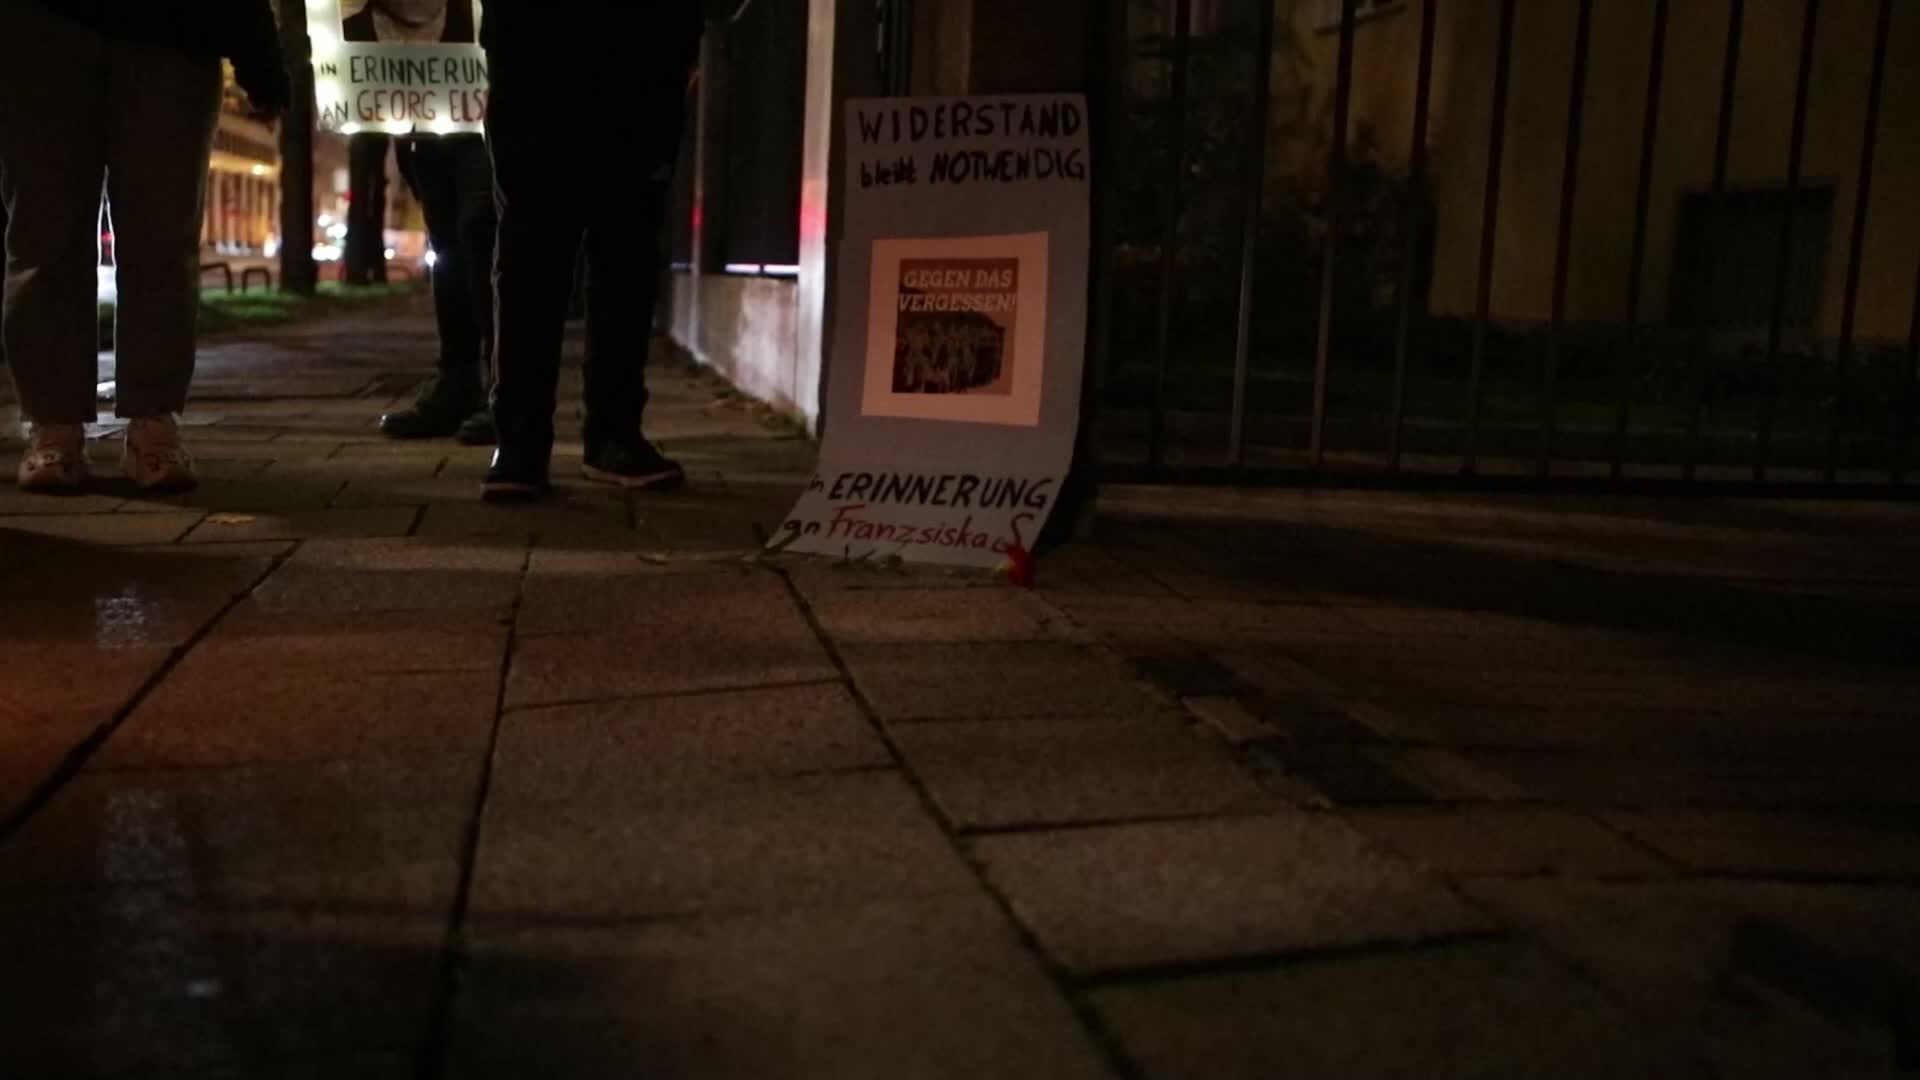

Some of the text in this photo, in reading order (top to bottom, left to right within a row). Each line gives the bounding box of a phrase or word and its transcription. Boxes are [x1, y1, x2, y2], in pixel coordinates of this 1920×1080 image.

[320, 63, 337, 76] IN
[322, 88, 489, 122] AN GEORG ELS
[859, 102, 1080, 143] WIDERSTAND
[930, 149, 1084, 184] NOTWENDIG
[903, 269, 1013, 288] GEGEN DAS
[899, 293, 1017, 312] VERGESSEN!
[828, 473, 1052, 508] ERINNERUNG
